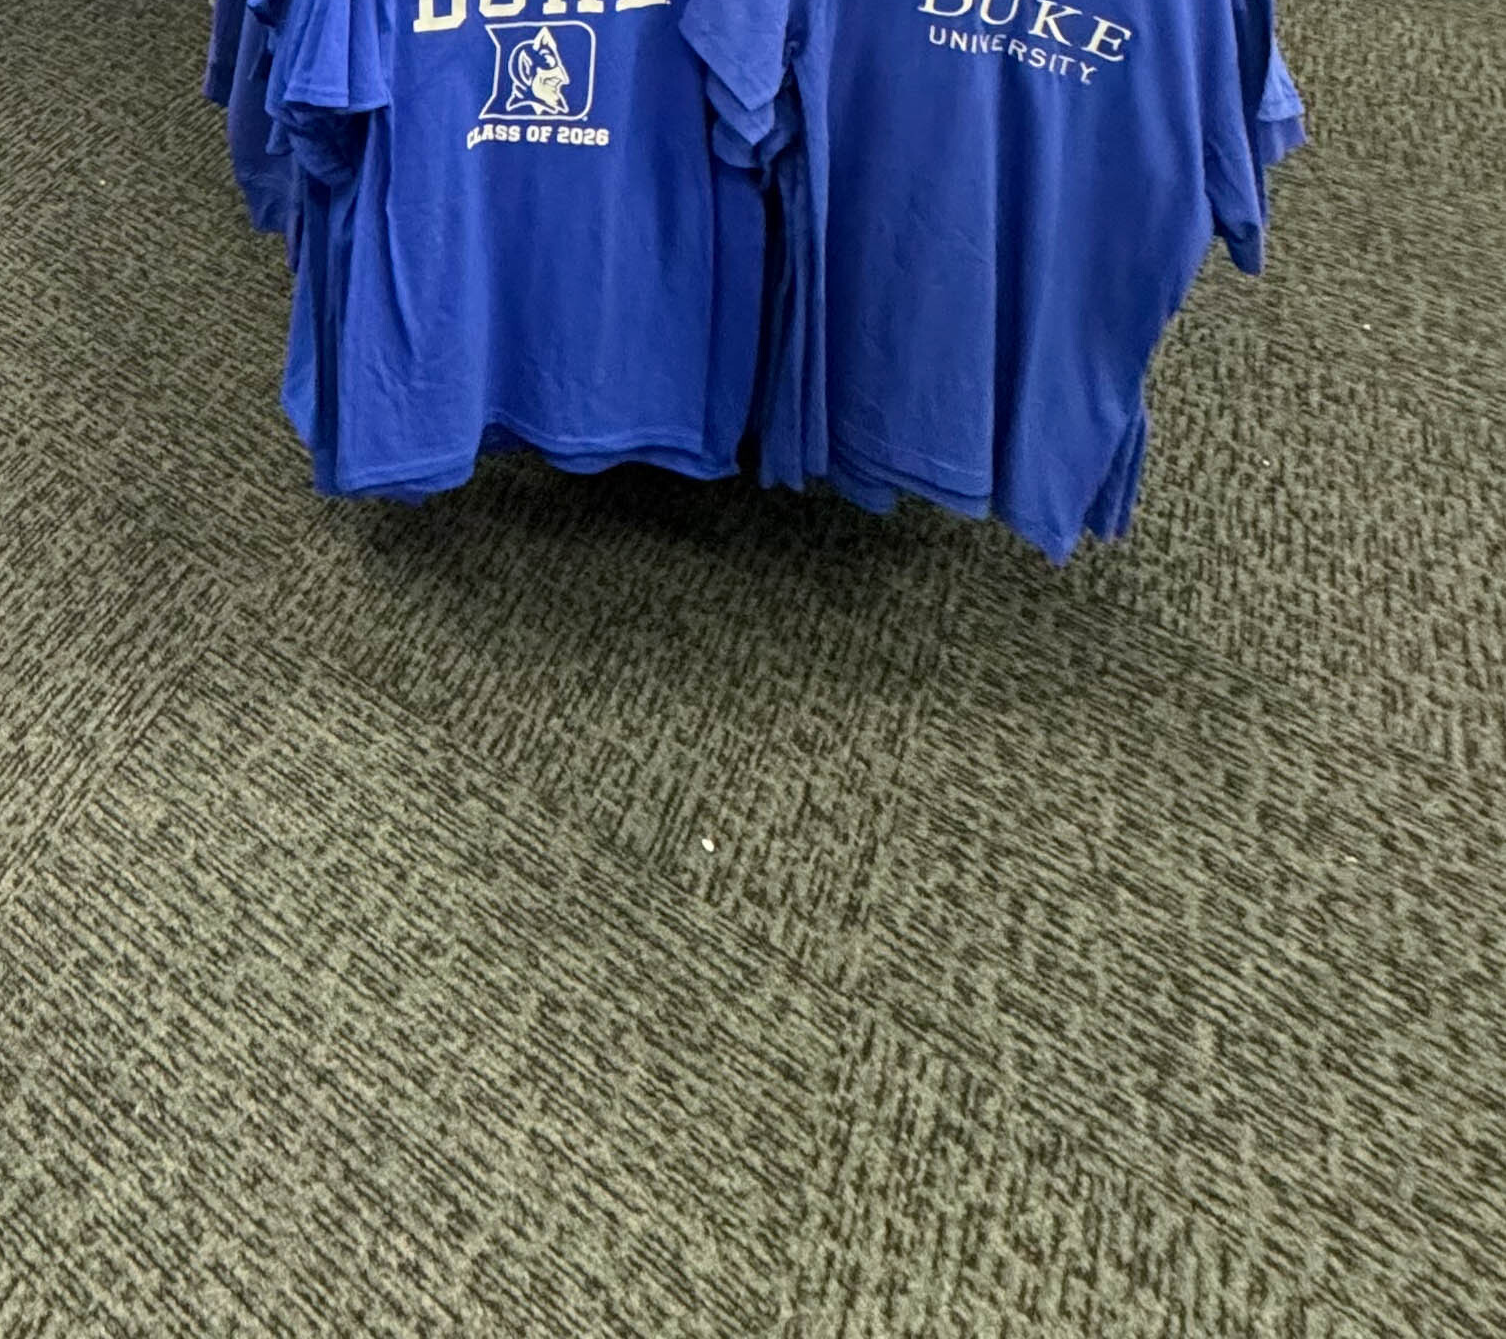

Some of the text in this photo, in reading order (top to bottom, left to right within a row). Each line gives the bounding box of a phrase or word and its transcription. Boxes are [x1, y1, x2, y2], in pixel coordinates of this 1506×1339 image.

[929, 25, 1098, 85] UNIVERSITY
[466, 123, 609, 149] CLASS OF 2026
